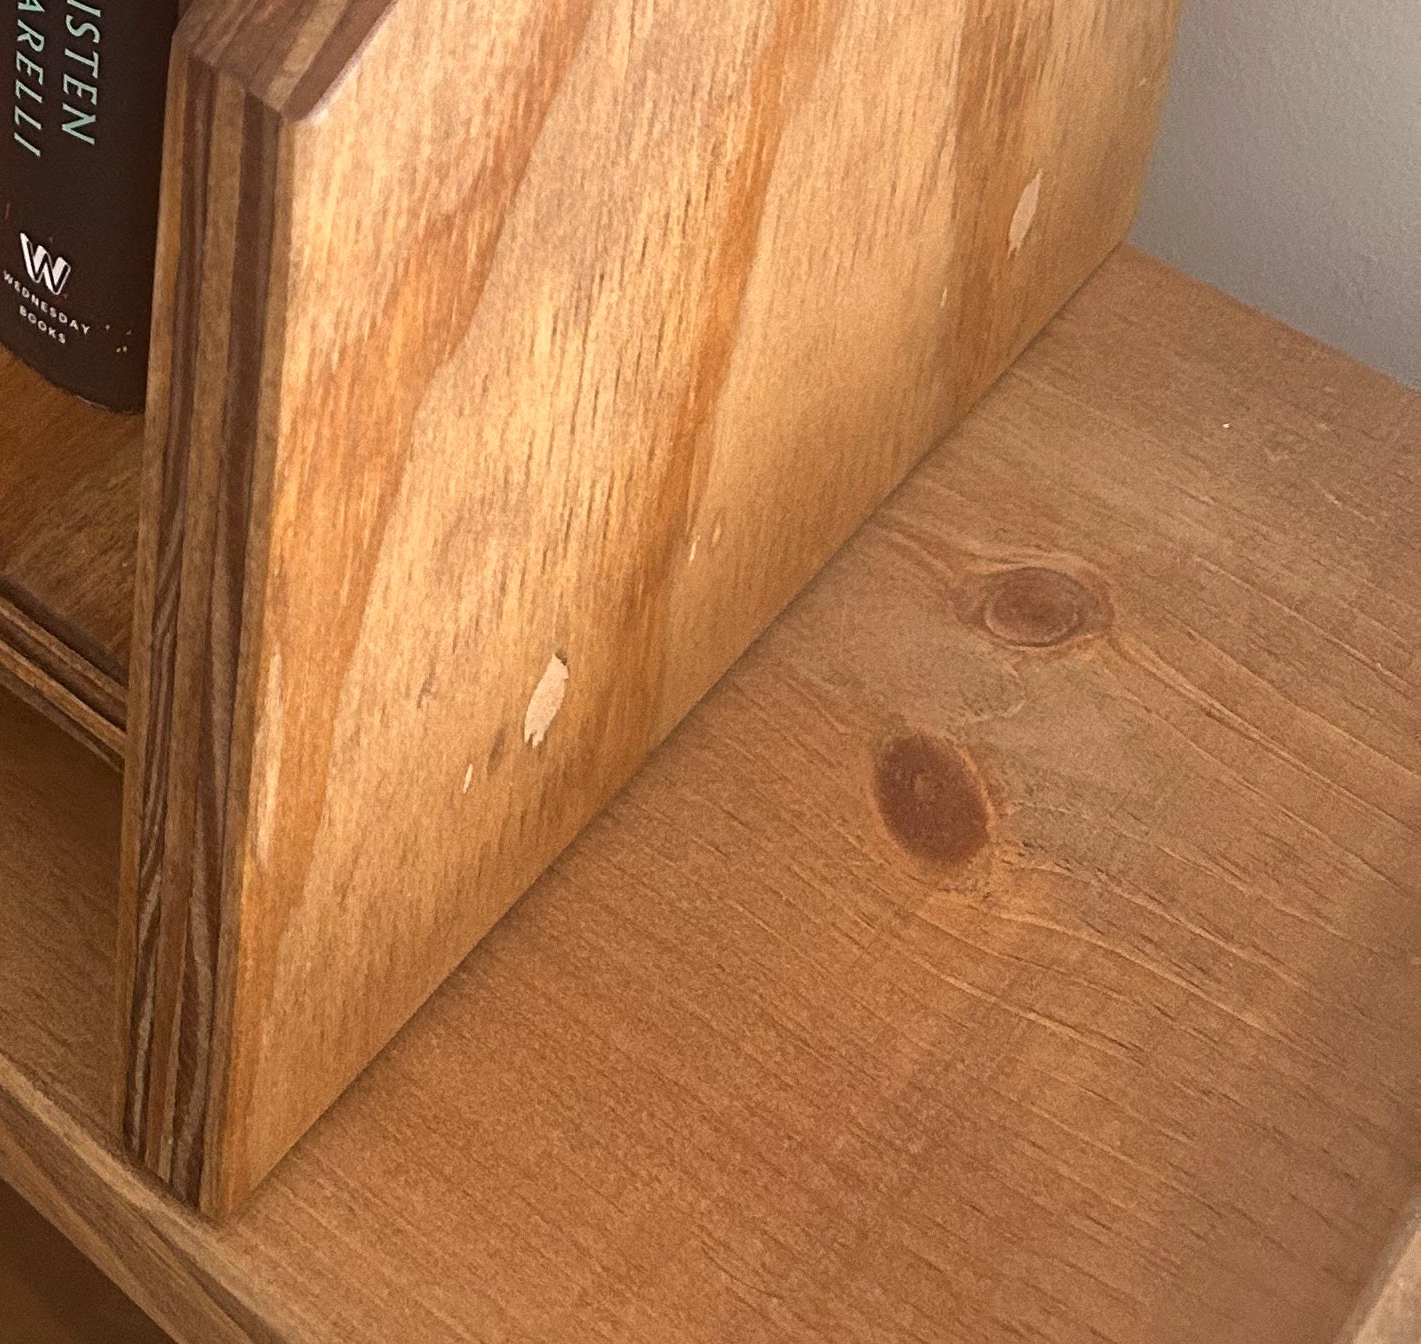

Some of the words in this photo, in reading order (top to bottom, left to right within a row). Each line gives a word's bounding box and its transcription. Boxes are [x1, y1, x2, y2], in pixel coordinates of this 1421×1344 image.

[19, 232, 72, 296] W
[2, 269, 91, 335] WEDNESDAY
[18, 304, 67, 344] BOOKS
